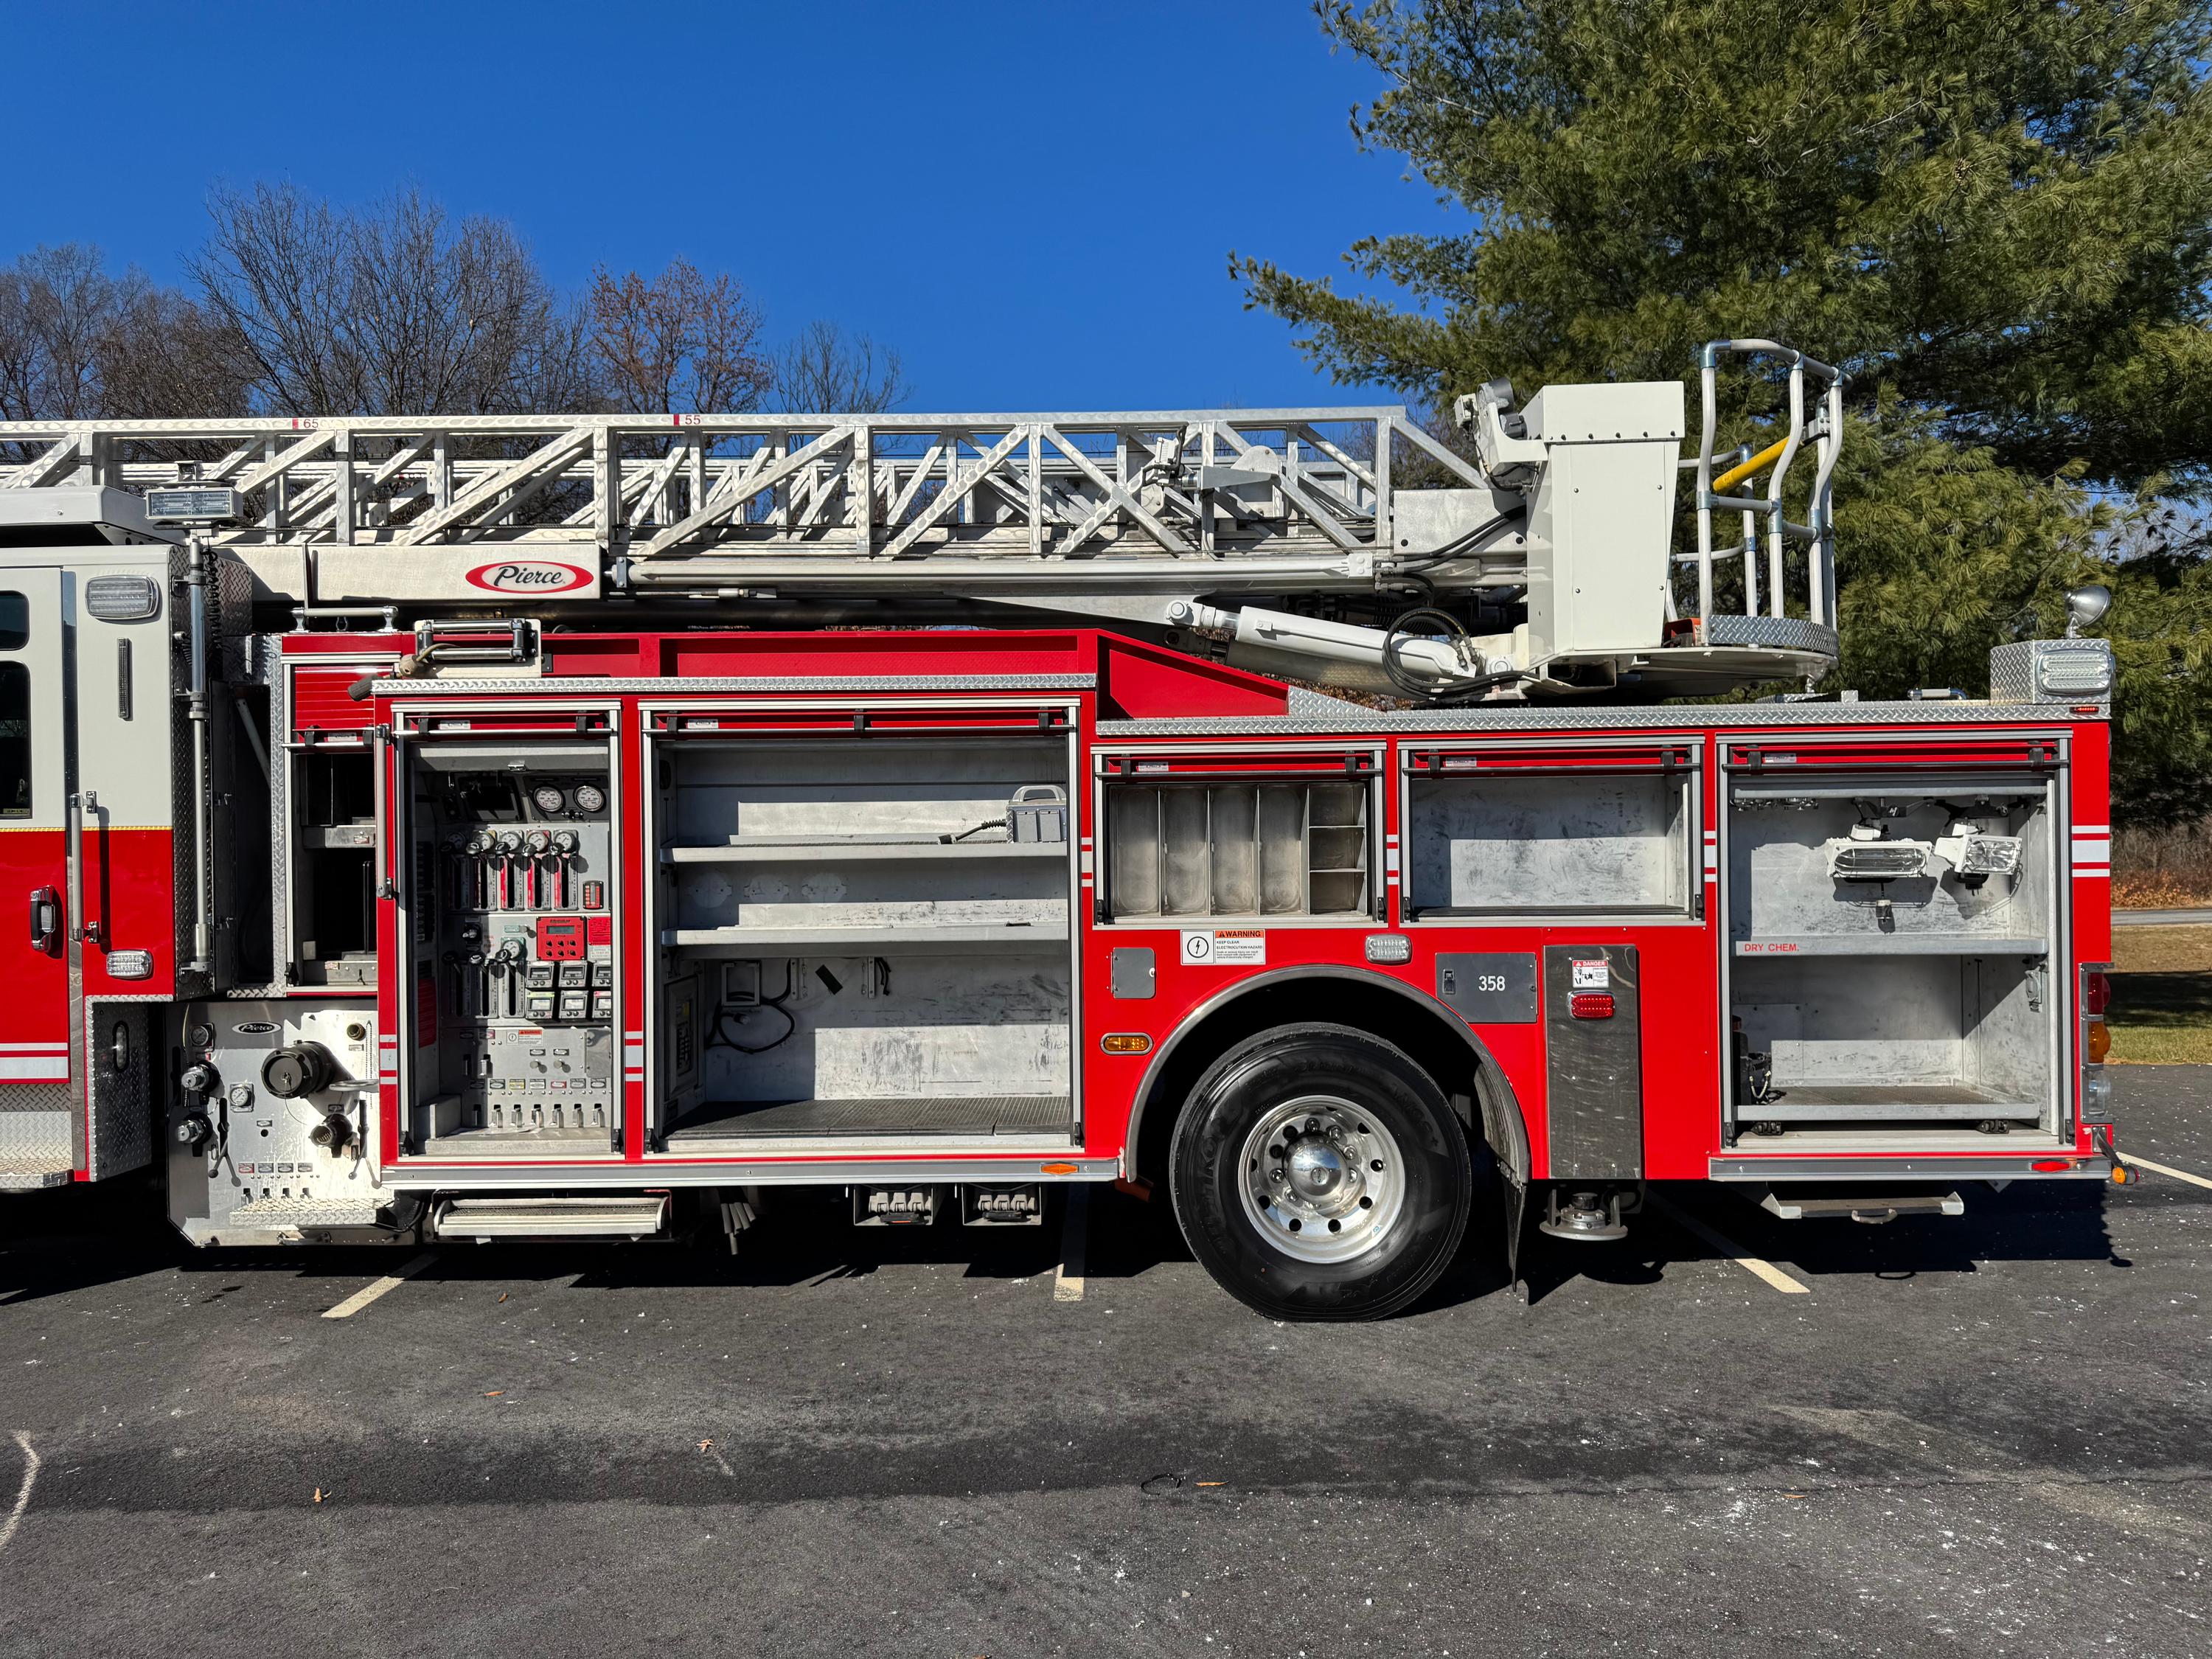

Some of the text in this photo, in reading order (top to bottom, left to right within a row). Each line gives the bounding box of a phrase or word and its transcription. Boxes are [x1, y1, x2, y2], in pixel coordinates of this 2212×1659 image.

[303, 419, 319, 428] 65
[685, 414, 700, 425] 55
[493, 566, 563, 586] Pierce
[1768, 943, 1799, 951] CHEM.
[1478, 975, 1506, 991] 358
